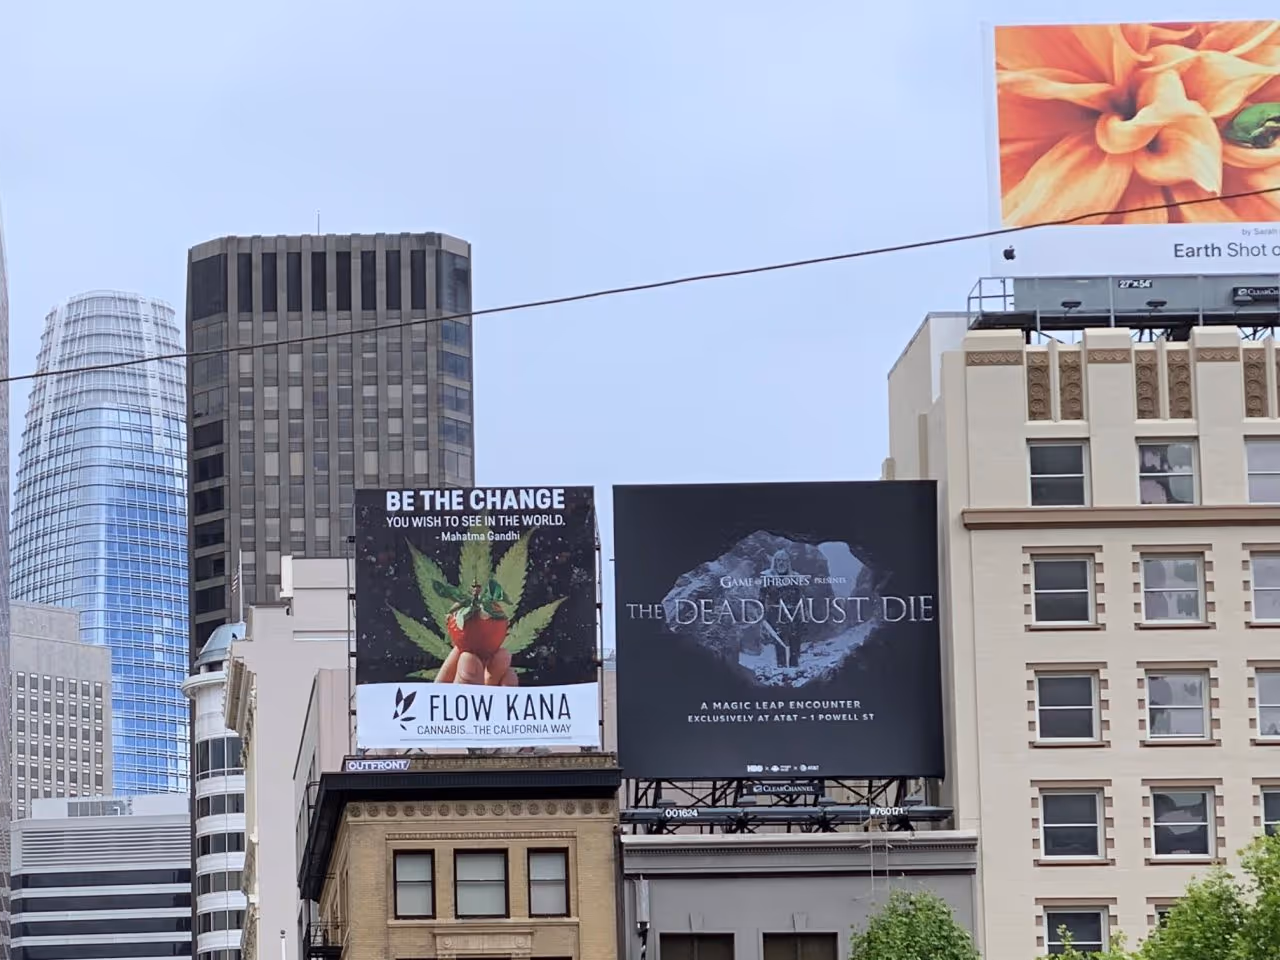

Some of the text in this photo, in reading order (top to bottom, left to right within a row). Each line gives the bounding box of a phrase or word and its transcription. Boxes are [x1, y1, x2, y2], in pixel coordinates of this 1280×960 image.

[1174, 242, 1221, 258] Earth
[1227, 242, 1268, 258] Shot
[386, 488, 566, 511] BE THE CHANGE
[386, 514, 566, 528] YOU WISH TO SEE IN THE WORLD.
[441, 532, 485, 541] Mahatma
[487, 530, 520, 541] Gandhi
[720, 575, 753, 588] GAME
[760, 574, 811, 588] THRONES
[626, 595, 935, 625] THE DEAD MUST DIE
[430, 693, 572, 722] FLOW KANA
[700, 700, 861, 710] A MAGIC LEAP ENCOUNTER
[687, 715, 754, 723] EXCLUSIVELY
[757, 714, 770, 722] AT
[773, 714, 798, 722] AT&T
[818, 713, 859, 721] POWELL
[862, 713, 875, 721] ST
[493, 724, 549, 735] CALIFORNIA
[551, 723, 572, 734] WAY
[348, 760, 407, 771] OUTFRONT
[665, 808, 698, 818] 001624
